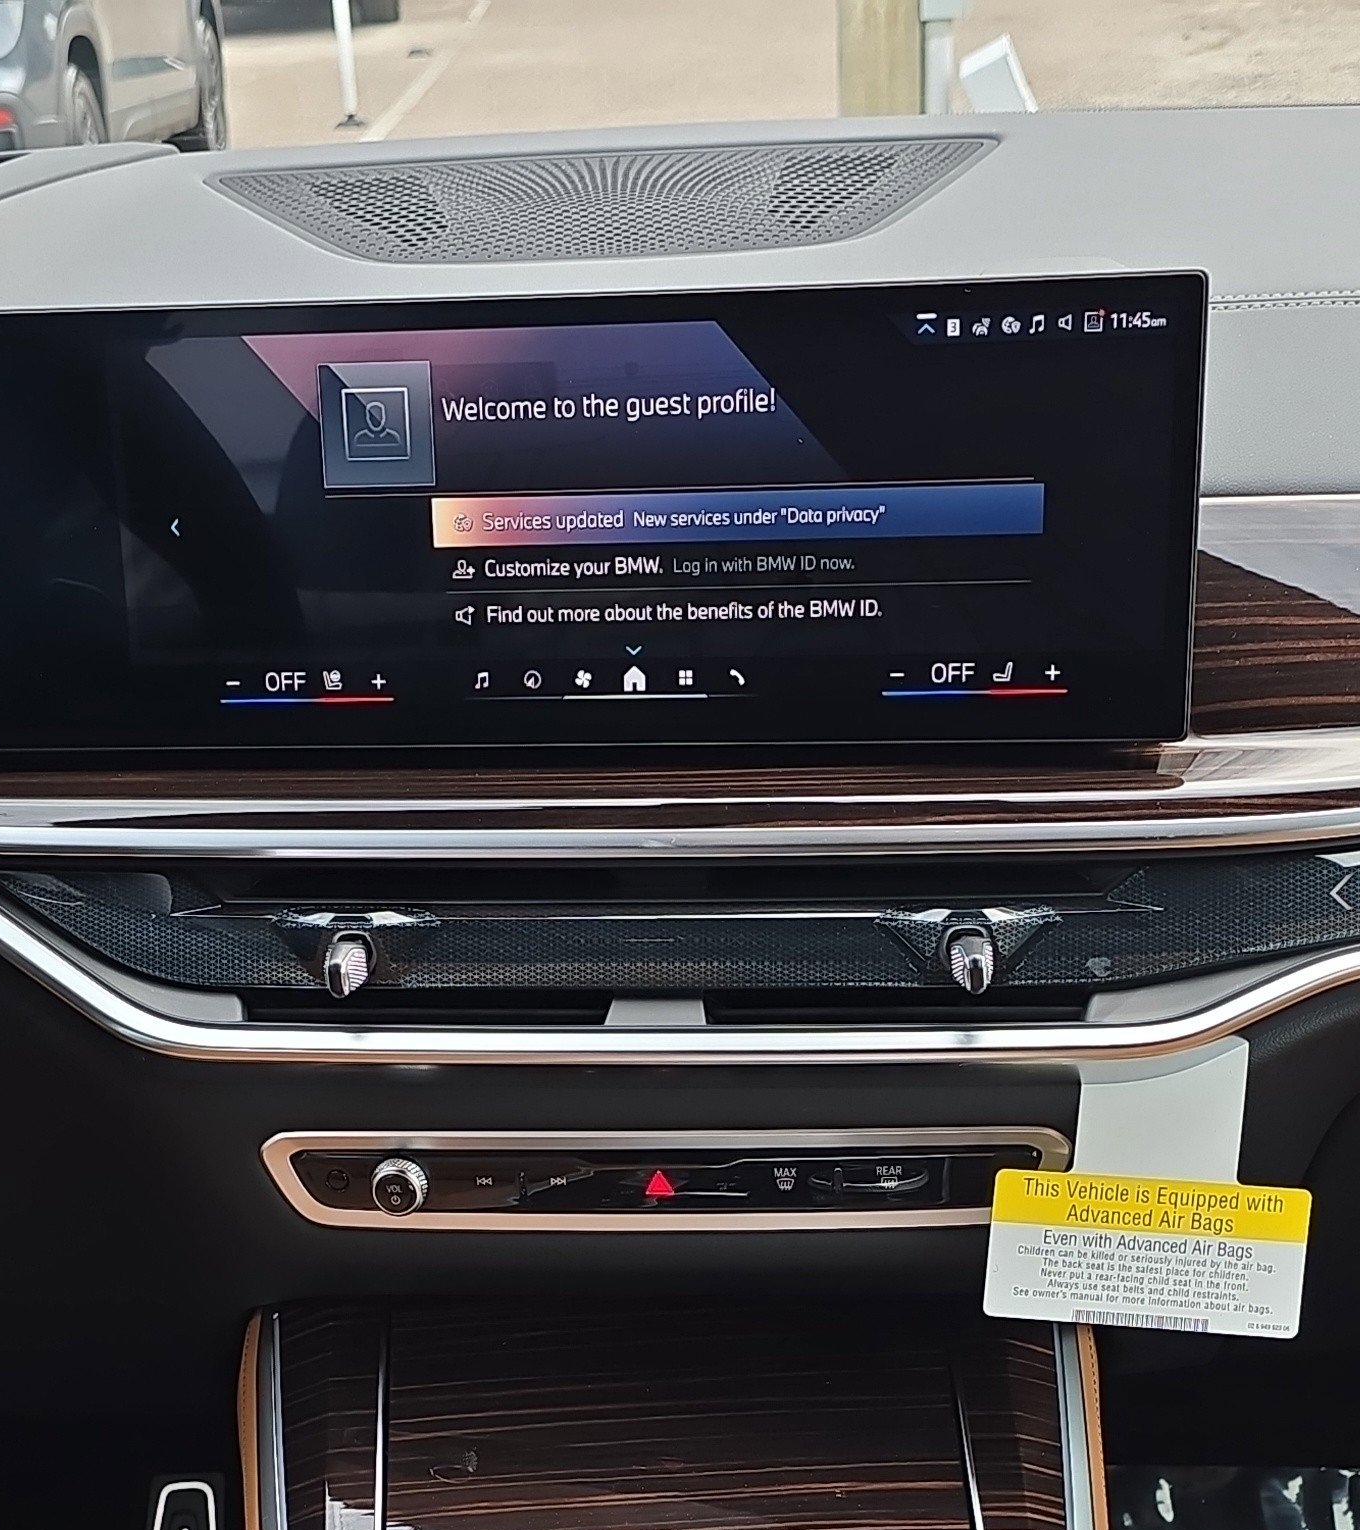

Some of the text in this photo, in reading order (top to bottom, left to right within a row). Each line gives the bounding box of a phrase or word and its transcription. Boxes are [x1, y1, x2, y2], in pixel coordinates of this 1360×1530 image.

[1110, 311, 1166, 329] 11:45am
[442, 388, 776, 422] Welcome to the guest profile!
[482, 510, 624, 531] Services updated
[633, 505, 885, 527] New services under "Data privacy"
[484, 556, 664, 578] Customize your BMW.
[673, 555, 855, 576] Log in with BMW ID now.
[486, 600, 882, 624] Find out more about the benefits of the BMW ID.
[265, 671, 306, 691] OFF
[931, 663, 975, 683] OFF
[774, 1167, 797, 1178] MAX
[876, 1166, 902, 1176] REAR
[385, 1184, 403, 1194] VOL
[1024, 1178, 1283, 1213] This Vehicle is Equipped with
[1066, 1204, 1234, 1235] Advanced Air Bags
[1043, 1229, 1253, 1261] Even with Advanced Air Bags
[1018, 1244, 1055, 1257] Children
[1058, 1249, 1074, 1258] can
[1077, 1250, 1088, 1259] be
[1091, 1250, 1115, 1261] killed
[1131, 1253, 1172, 1267] seriously
[1175, 1257, 1206, 1268] injured
[1210, 1260, 1220, 1271] by
[1224, 1260, 1238, 1270] the
[1241, 1262, 1254, 1271] air
[1257, 1262, 1276, 1274] bag.
[1043, 1257, 1249, 1281] The back seat is the safest place for children.
[1040, 1268, 1067, 1278] Never
[1069, 1270, 1084, 1280] put
[1095, 1273, 1144, 1285] rear-facing
[1148, 1276, 1169, 1286] child
[1172, 1278, 1191, 1288] seat
[1195, 1279, 1202, 1288] in
[1206, 1280, 1220, 1289] the
[1224, 1281, 1248, 1291] front.
[1047, 1279, 1239, 1301] Always use seat belts and child restraints.
[1013, 1287, 1273, 1315] See owner's manual for more information about air bags.
